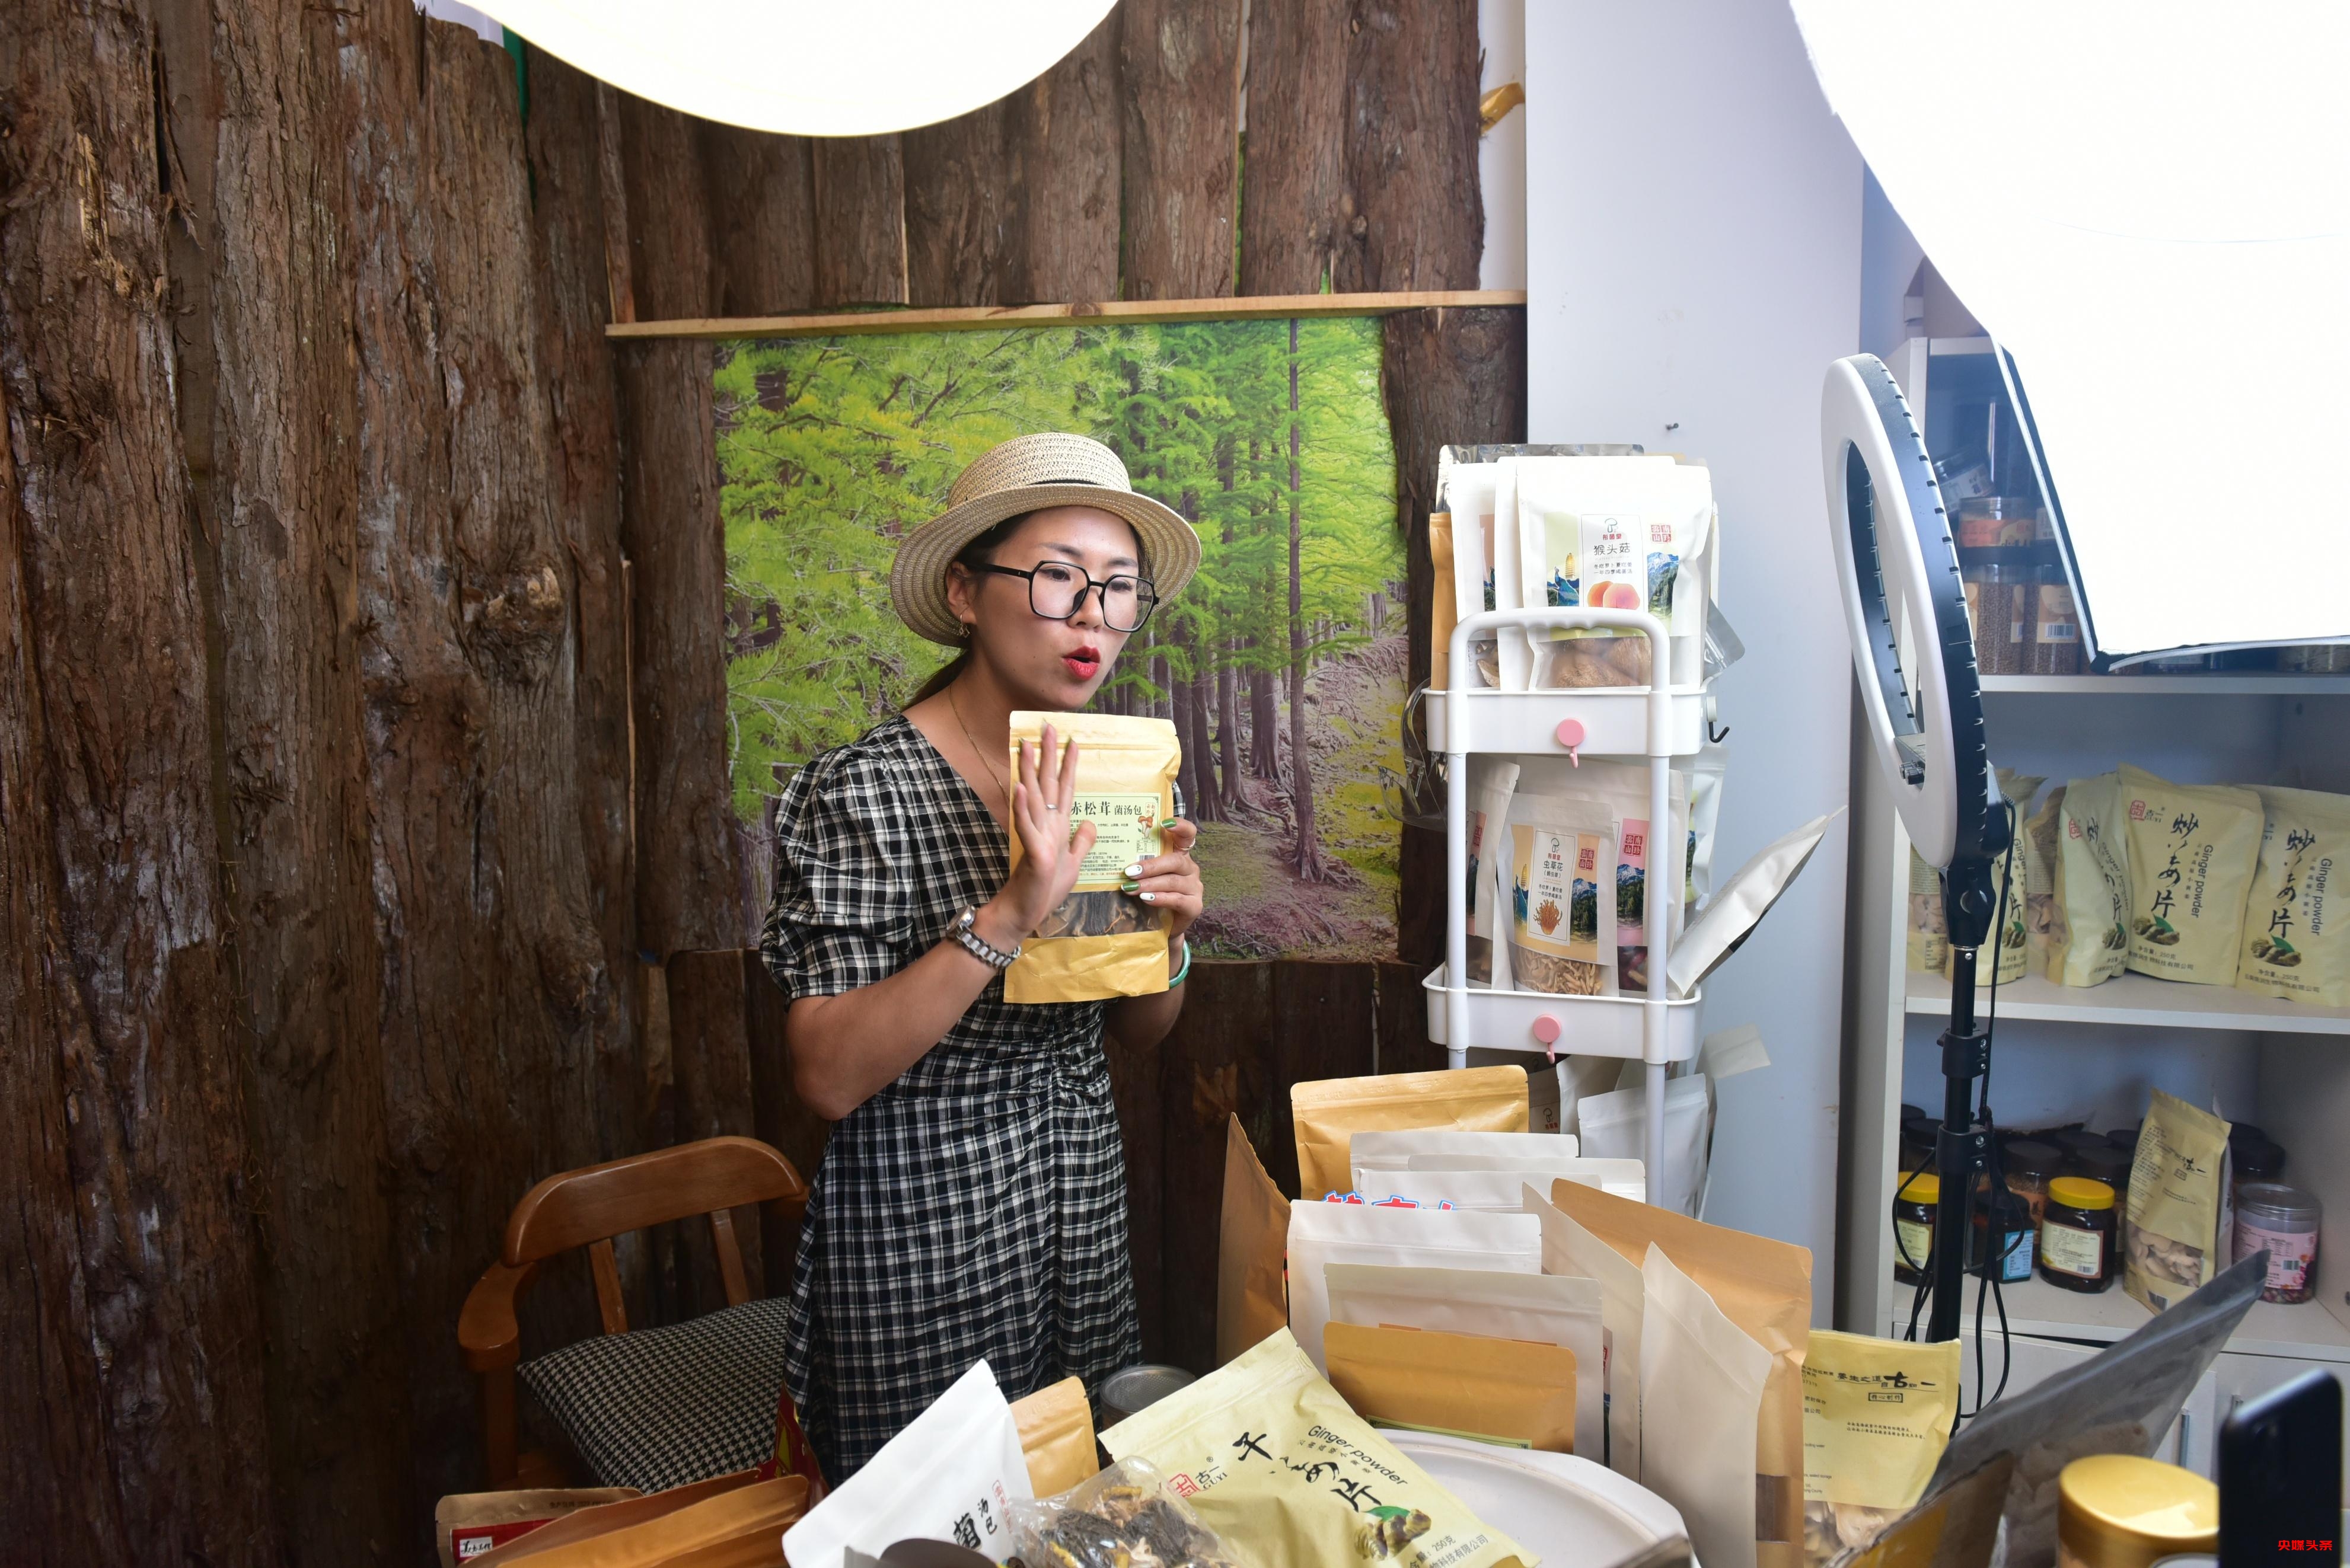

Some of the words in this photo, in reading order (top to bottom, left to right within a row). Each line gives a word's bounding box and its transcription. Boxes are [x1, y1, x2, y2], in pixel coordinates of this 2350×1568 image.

[1593, 542, 1630, 556] 猴头菇
[1071, 801, 1111, 816] 赤松茸
[1114, 804, 1142, 816] 菌汤包
[1543, 860, 1563, 871] 虫草花
[2198, 844, 2214, 879] Ginger
[2316, 858, 2332, 894] Ginger
[2192, 880, 2205, 918] powder
[2311, 895, 2325, 936] powder
[1308, 1425, 1354, 1449] Ginger
[1349, 1449, 1408, 1486] powder
[1195, 1465, 1220, 1483] 古一
[1203, 1473, 1228, 1490] GUYI
